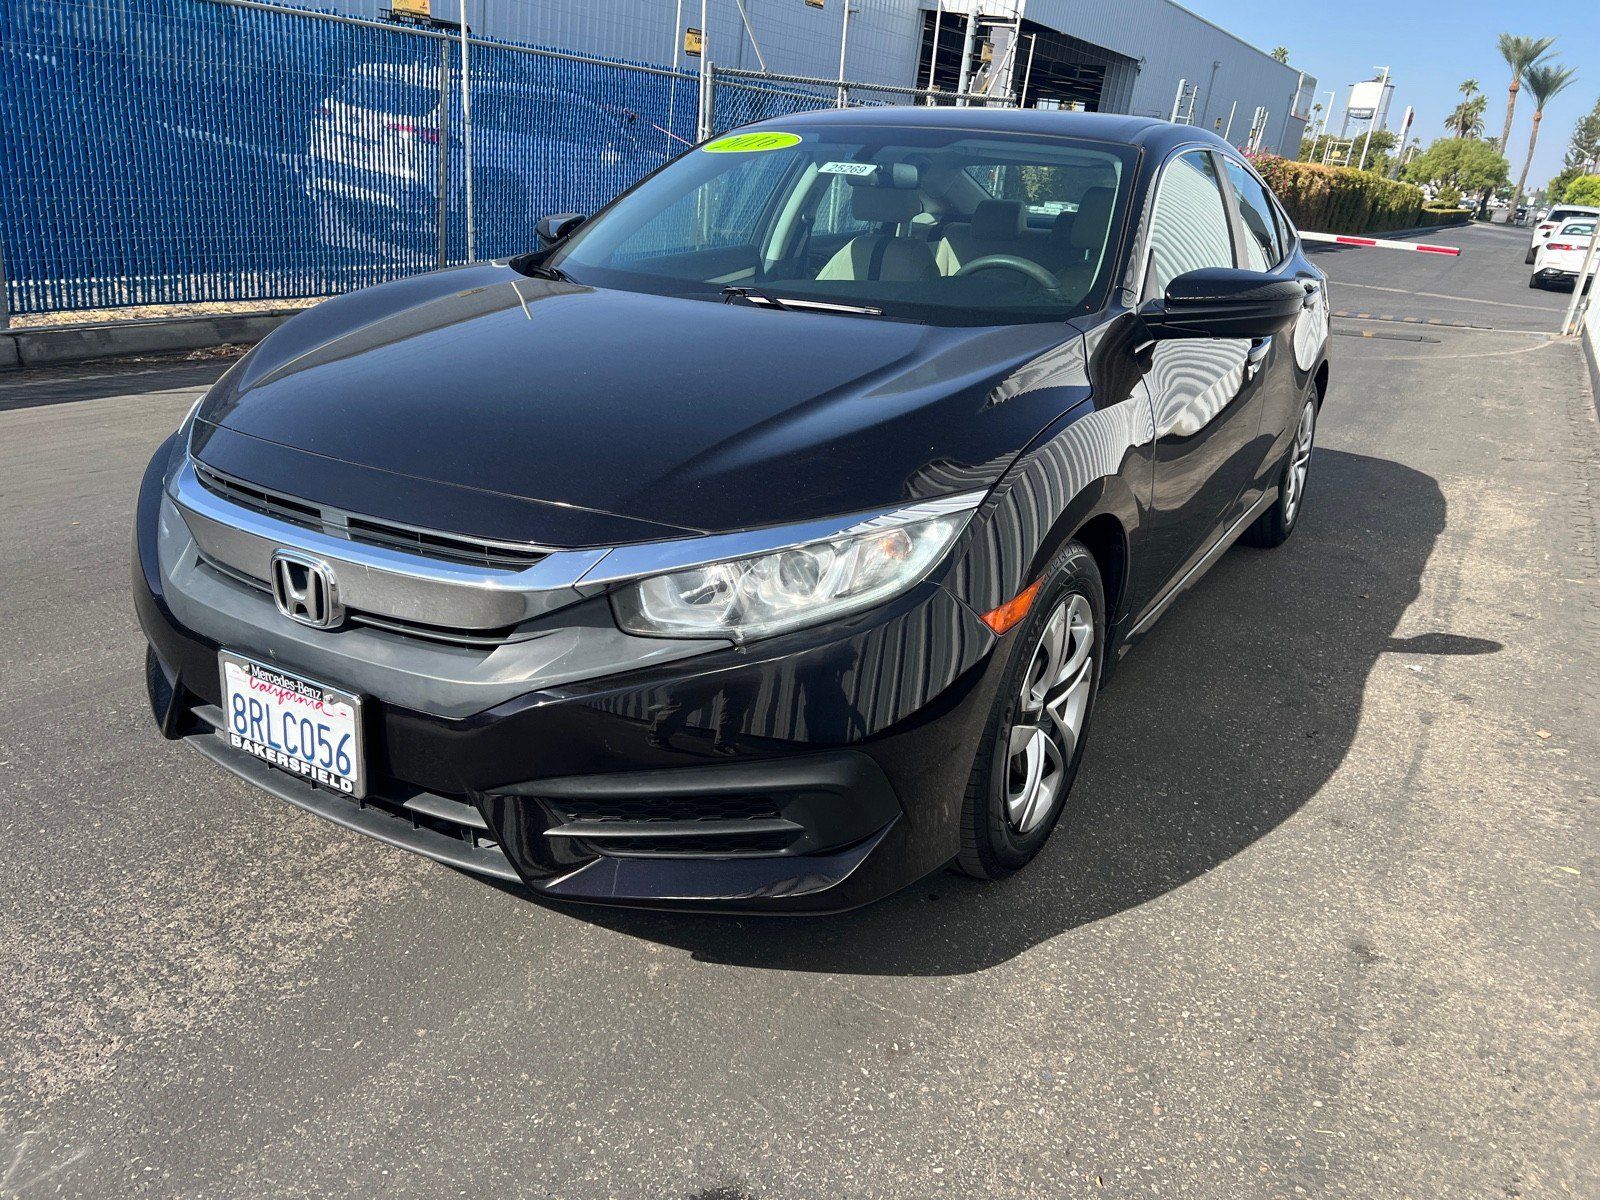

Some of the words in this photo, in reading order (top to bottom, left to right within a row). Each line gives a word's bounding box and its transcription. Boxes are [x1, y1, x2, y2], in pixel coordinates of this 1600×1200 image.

[826, 163, 867, 174] 25269
[250, 664, 323, 701] Mercedes-Benz
[232, 692, 351, 776] 8RLC056
[231, 732, 353, 793] BAKERSFIELD
